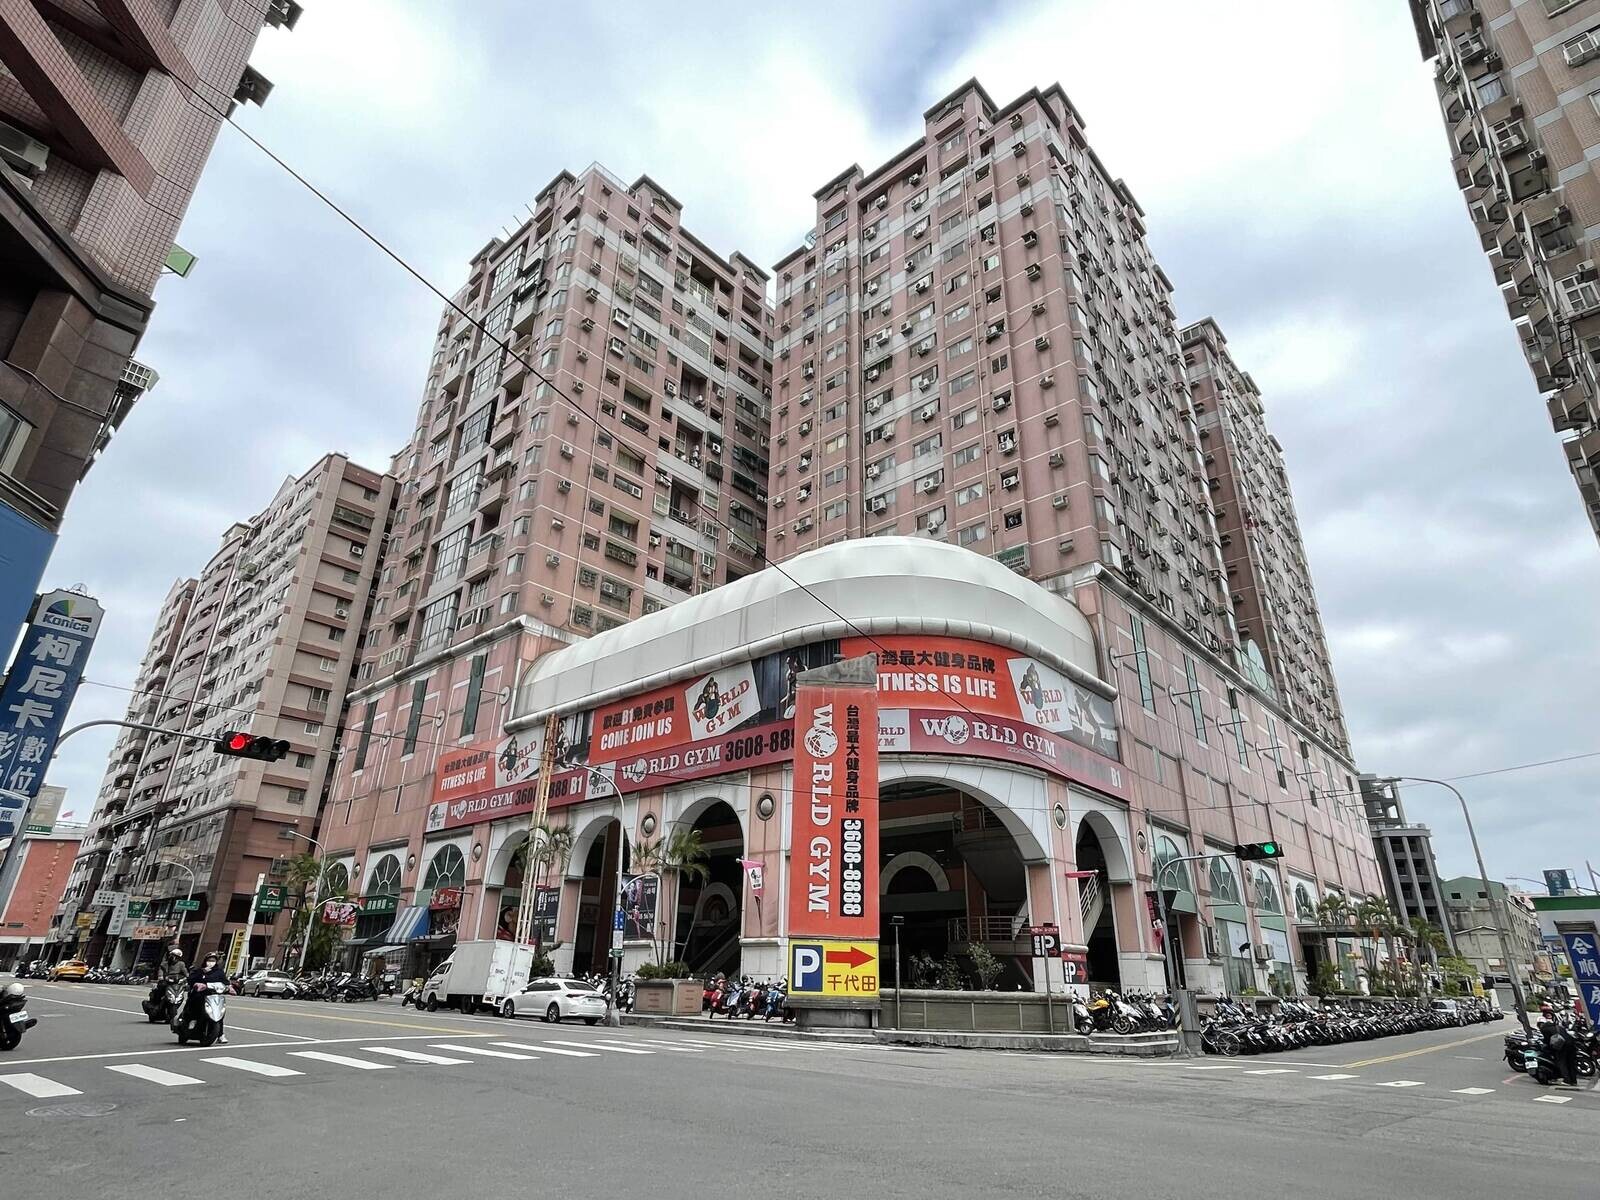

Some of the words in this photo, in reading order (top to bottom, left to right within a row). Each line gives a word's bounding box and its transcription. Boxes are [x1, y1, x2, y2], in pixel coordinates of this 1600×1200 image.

[43, 613, 90, 633] Konica
[8, 633, 83, 729] 柯尼卡
[876, 672, 939, 692] ITNESS
[943, 674, 962, 694] IS
[966, 677, 997, 699] LIFE
[601, 728, 630, 751] COME
[631, 721, 655, 743] JOIN
[657, 716, 673, 736] US
[706, 703, 742, 733] GYM
[1035, 708, 1060, 724] GYM
[622, 755, 680, 784] WORLD
[684, 744, 721, 767] GYM
[725, 729, 795, 762] 3608-88
[920, 715, 1017, 745] WORLD
[1022, 732, 1056, 759] GYM
[9, 735, 48, 796] 數位
[506, 758, 530, 782] GYM
[804, 703, 839, 826] WORLD
[845, 704, 860, 813] 台灣最大健身品牌
[1110, 766, 1122, 789] B1
[441, 773, 466, 792] FITNESS
[466, 770, 474, 785] IS
[474, 766, 487, 782] LIFE
[450, 797, 488, 820] WORLD
[490, 791, 514, 809] GYM
[570, 776, 583, 795] B1
[808, 835, 832, 914] GYM
[842, 818, 862, 916] 3608-8888
[794, 948, 820, 988] P
[1571, 937, 1600, 977] 合順
[827, 974, 876, 992] 千代田
